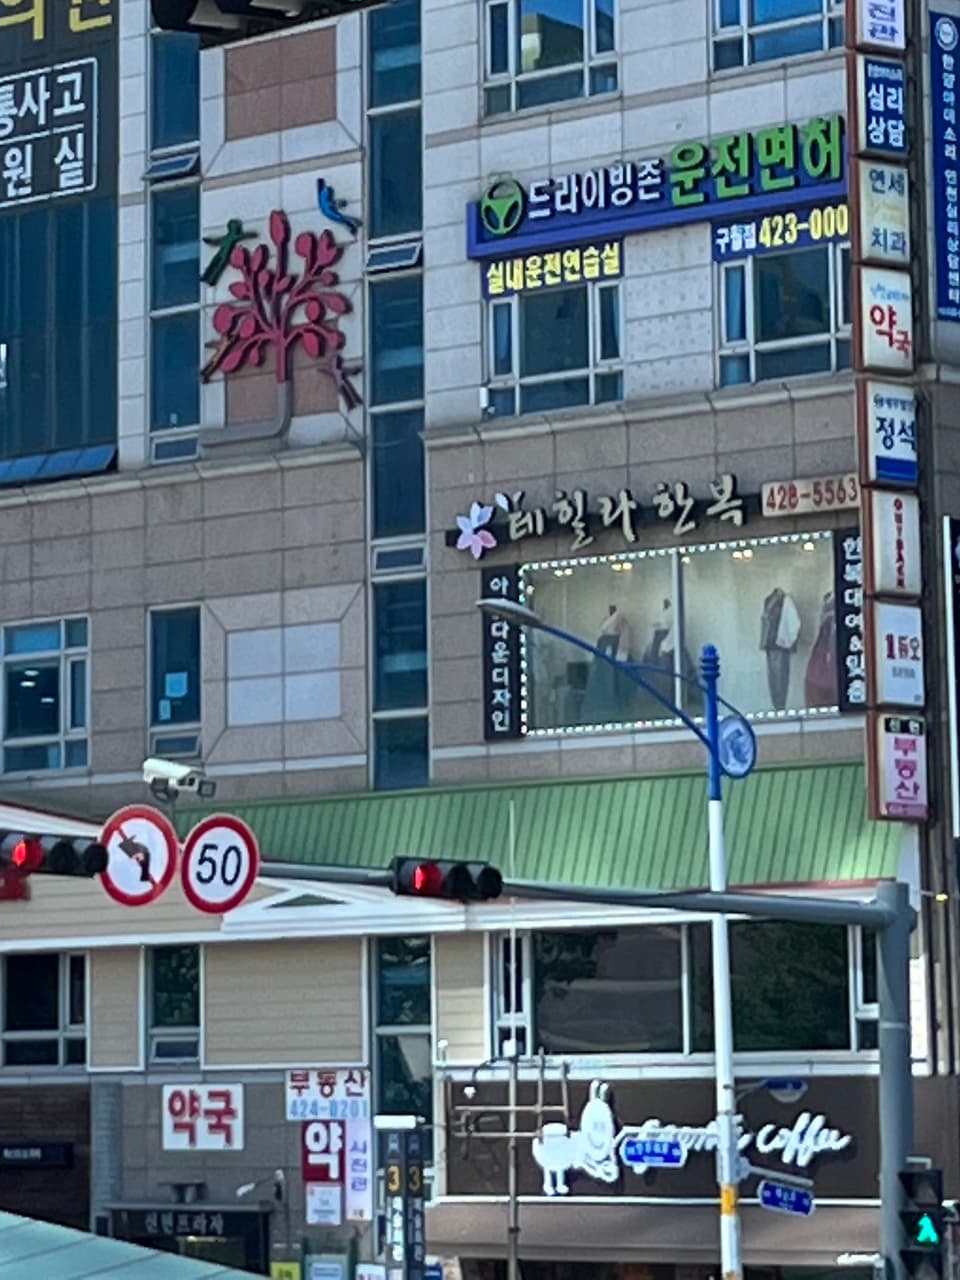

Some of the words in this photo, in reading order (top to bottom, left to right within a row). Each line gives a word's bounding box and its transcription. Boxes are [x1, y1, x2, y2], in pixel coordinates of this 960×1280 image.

[867, 83, 904, 114] 심리
[867, 118, 905, 148] 상담
[528, 157, 663, 219] 드라이빙존
[669, 115, 843, 206] 운전면허
[869, 168, 905, 197] 연세
[871, 227, 907, 257] 치과
[487, 242, 620, 294] 실내운전연습실
[869, 304, 912, 360] 약국
[875, 416, 917, 453] 정석
[766, 477, 858, 512] 428-5563
[490, 576, 513, 734] 아다운디자인
[894, 736, 921, 801] 부동산
[196, 843, 241, 886] 50
[290, 1071, 367, 1098] 부동산
[168, 1089, 238, 1148] 약국
[306, 1122, 342, 1180] 약
